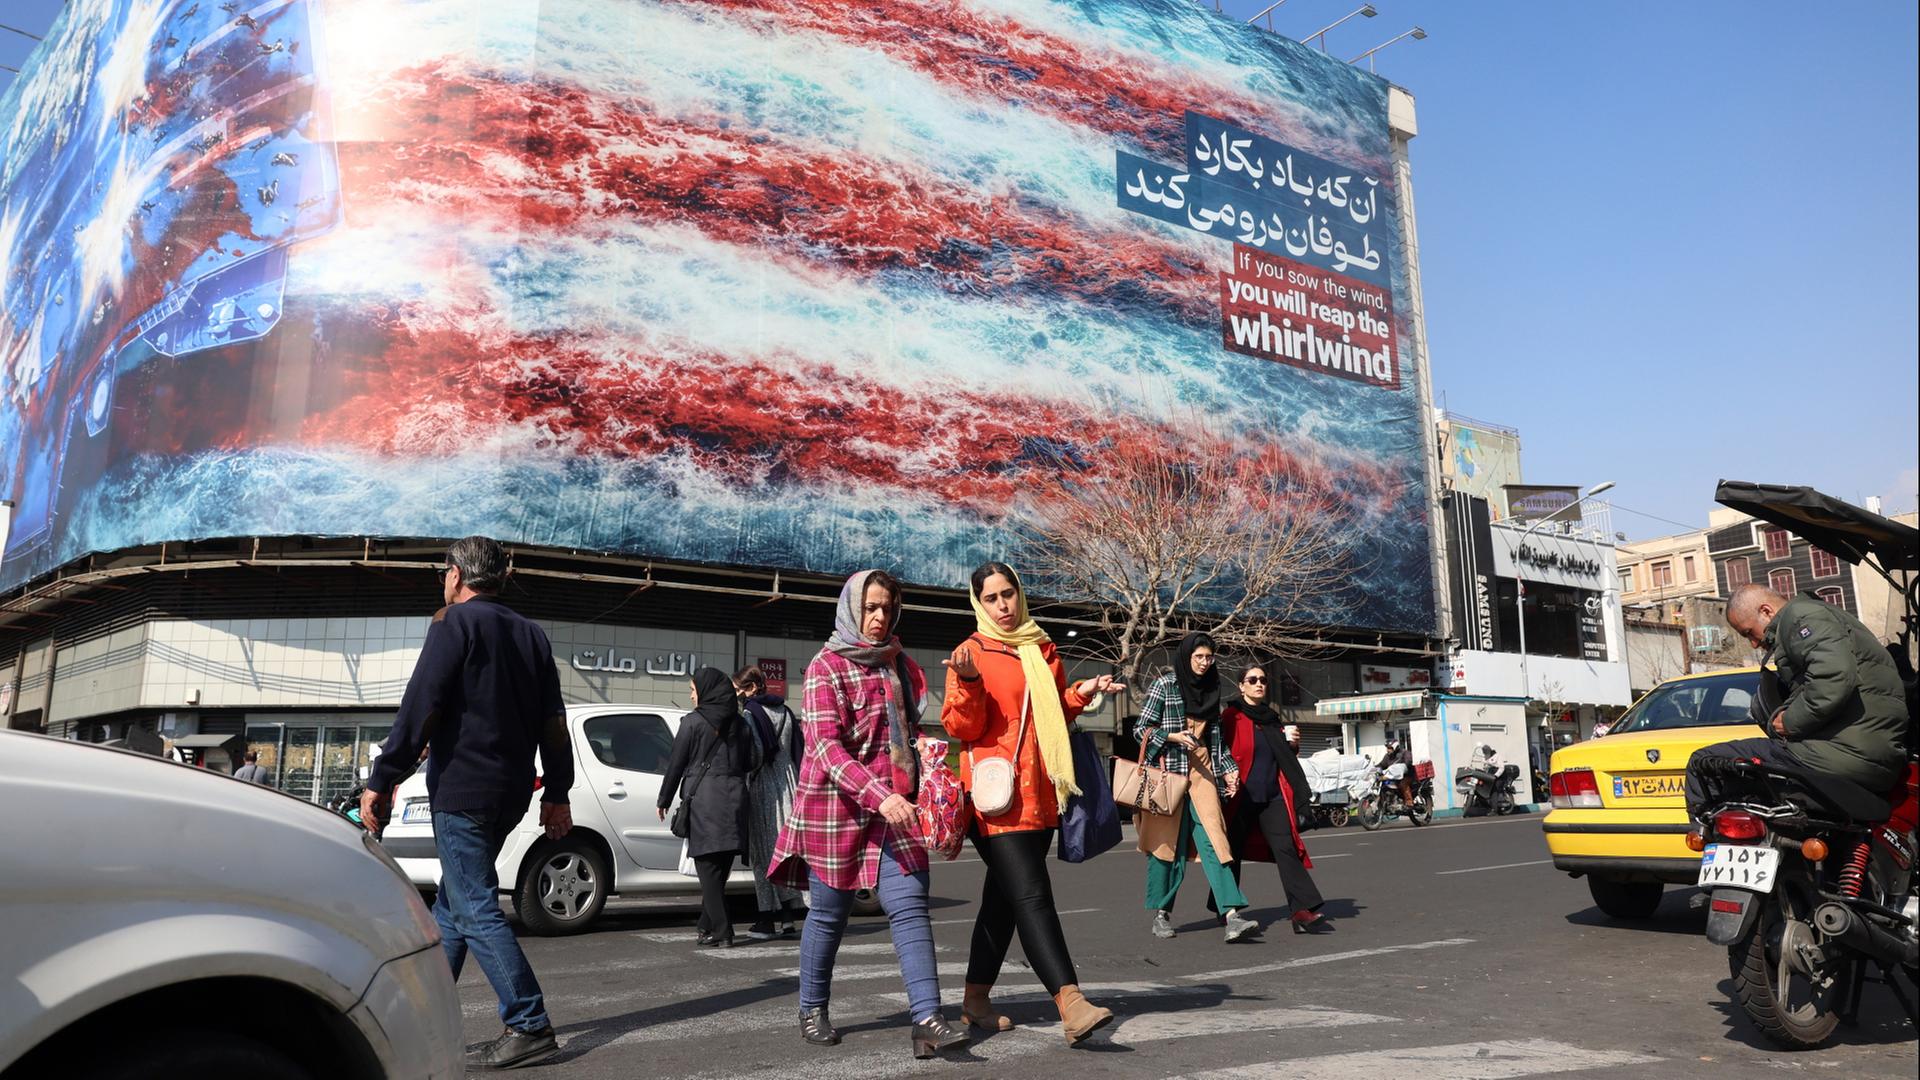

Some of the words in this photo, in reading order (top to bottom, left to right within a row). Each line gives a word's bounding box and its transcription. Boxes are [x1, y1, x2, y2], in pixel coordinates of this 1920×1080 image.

[1194, 130, 1264, 190] بکارد
[1270, 154, 1315, 207] باد
[1285, 215, 1381, 272] طوفان
[1227, 278, 1269, 306] you
[1272, 289, 1307, 317] will
[1310, 301, 1355, 334] reap
[1357, 310, 1390, 339] the
[1239, 252, 1251, 270] If
[1255, 260, 1284, 280] you
[1288, 270, 1319, 290] sow
[1323, 277, 1347, 298] the
[1350, 289, 1388, 313] wind,
[1230, 311, 1393, 383] whirlwind
[1519, 497, 1568, 508] SAMSUNG
[1477, 574, 1493, 650] SAMSUNG
[572, 648, 637, 673] ملت
[761, 663, 783, 671] 984
[1703, 866, 1768, 885] ۷۷۱۱۶
[1727, 848, 1767, 865] ۱۵۳
